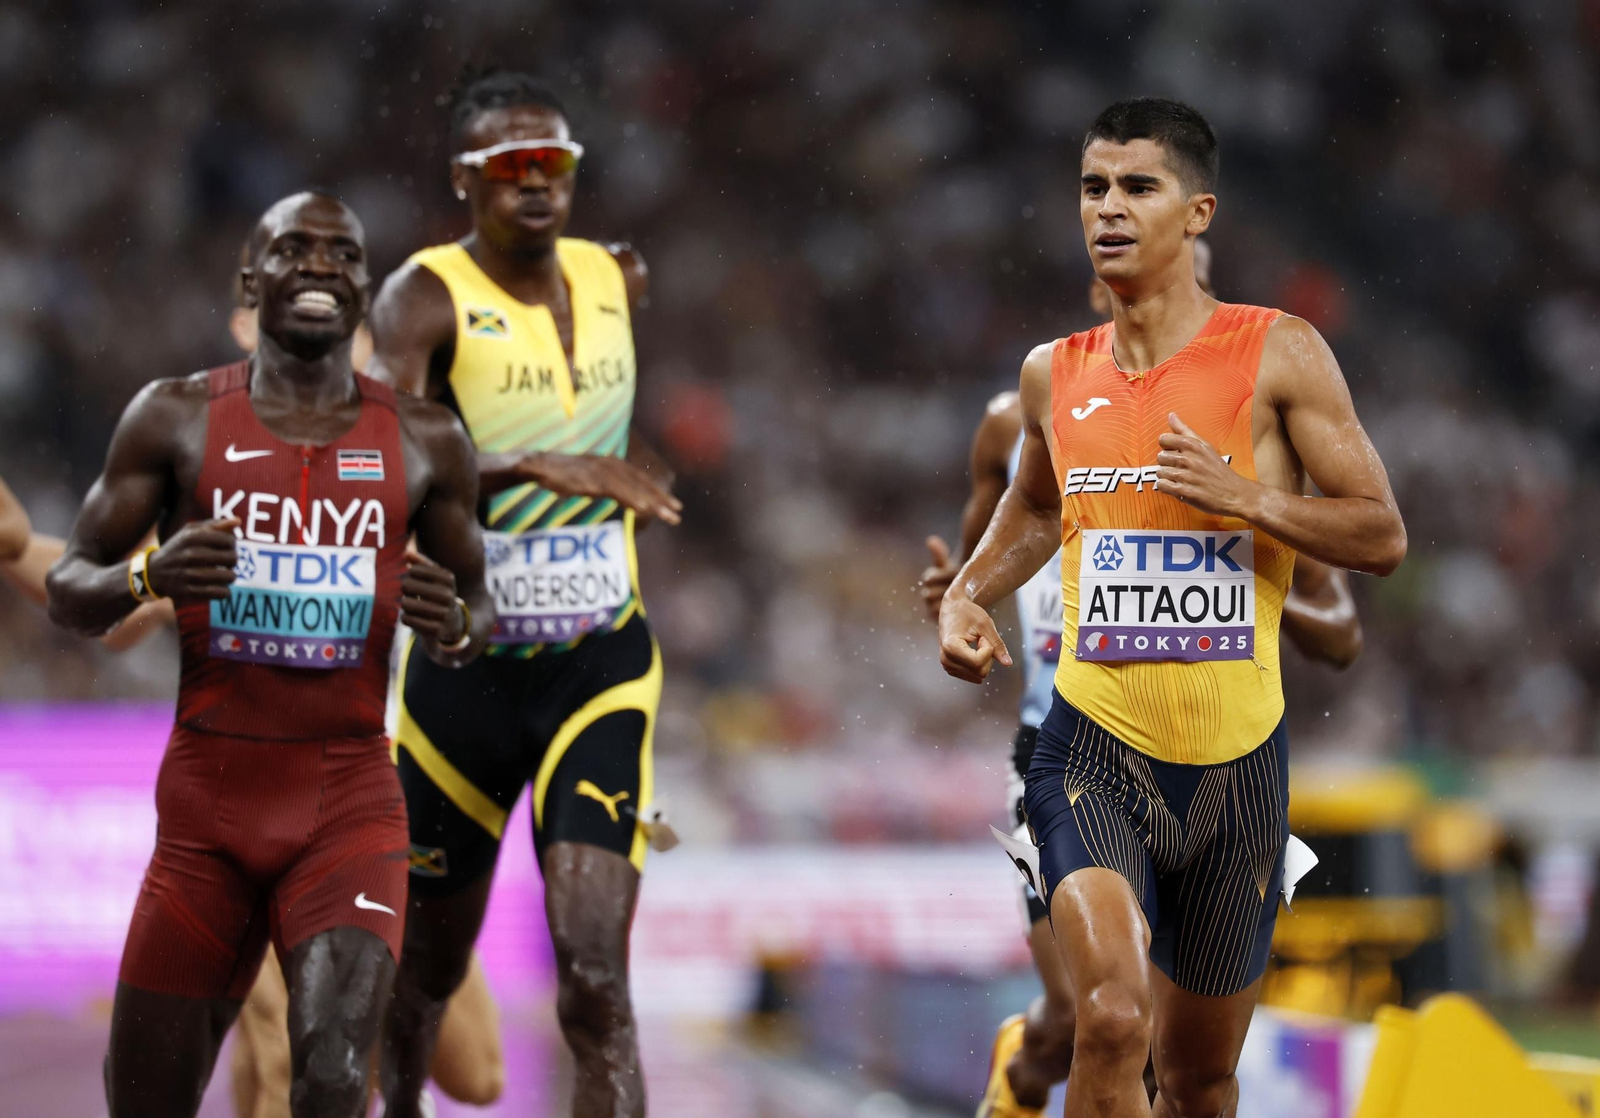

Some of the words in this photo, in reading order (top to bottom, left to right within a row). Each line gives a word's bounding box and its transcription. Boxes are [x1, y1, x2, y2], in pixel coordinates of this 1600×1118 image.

[213, 487, 385, 548] KENYA
[515, 531, 608, 564] TDK
[1124, 535, 1243, 573] TDK
[258, 550, 362, 586] TDK
[493, 572, 620, 608] NDERSON
[1087, 584, 1246, 623] ATTAOUI
[219, 592, 367, 633] WANYONYI
